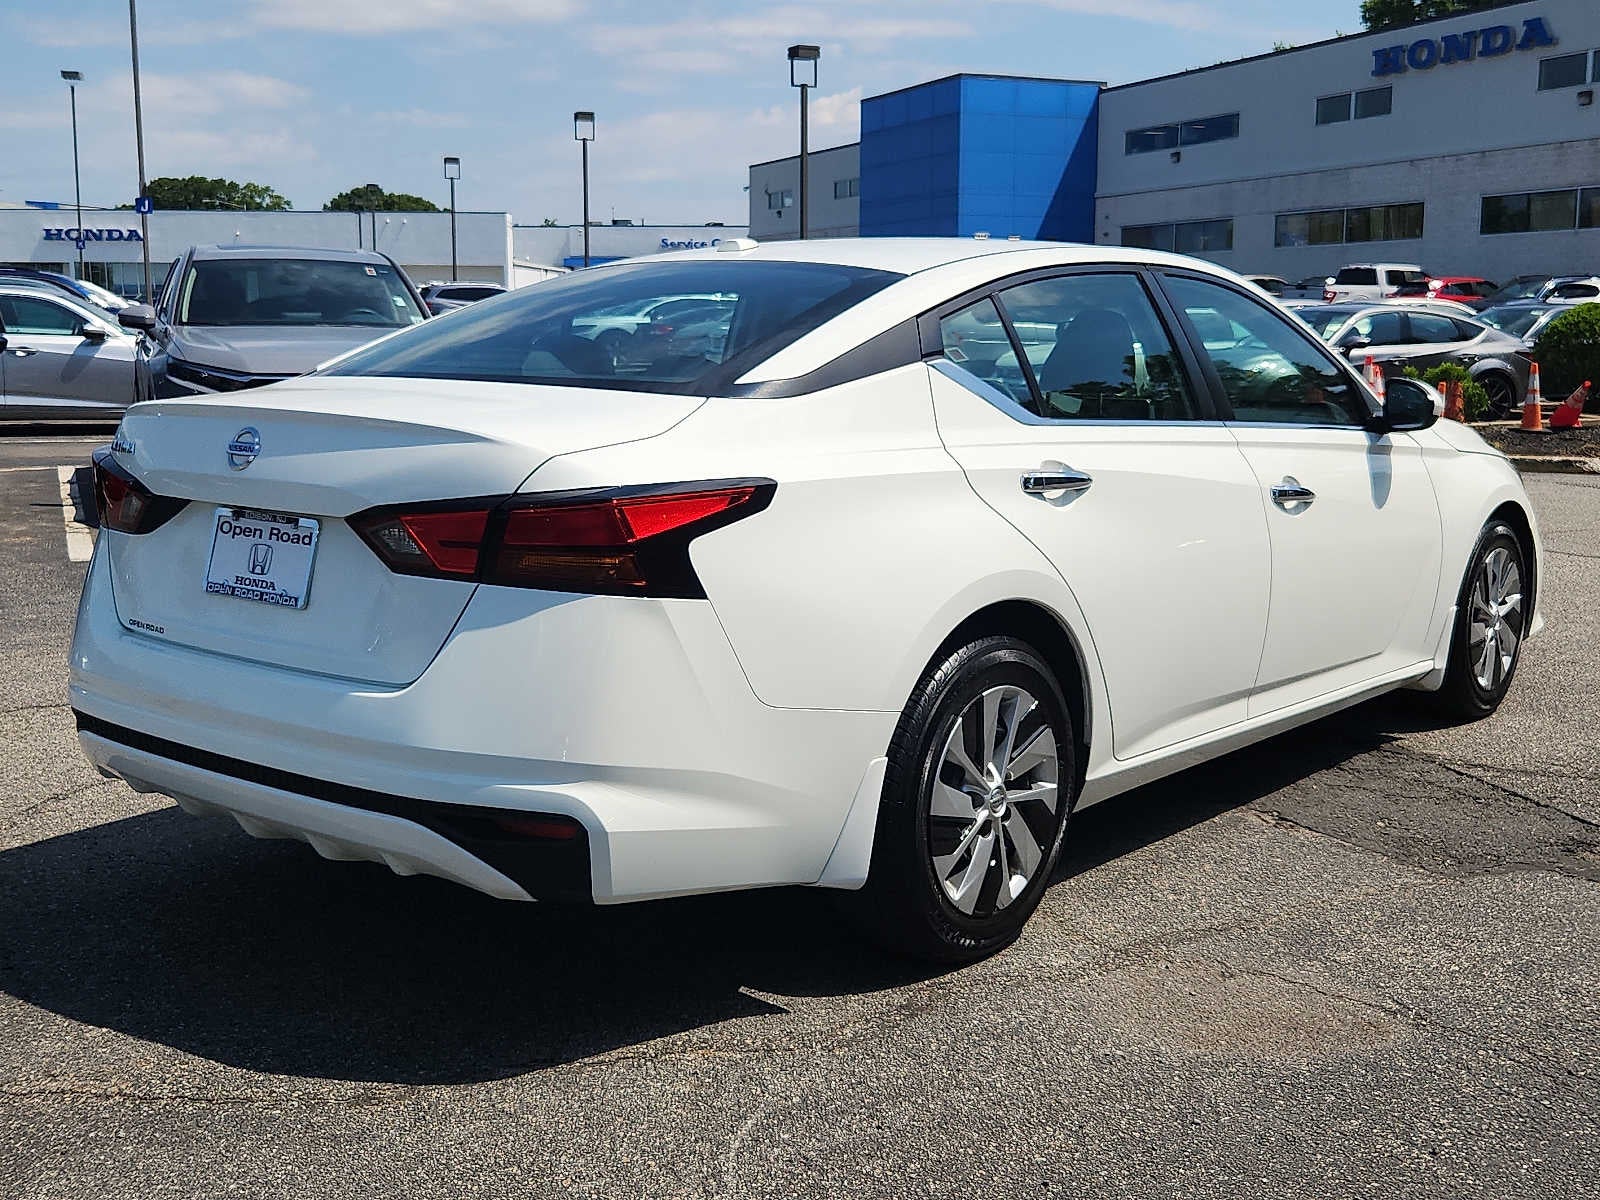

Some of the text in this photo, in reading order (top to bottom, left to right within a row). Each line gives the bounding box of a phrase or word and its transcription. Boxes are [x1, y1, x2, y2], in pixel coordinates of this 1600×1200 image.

[1371, 17, 1557, 76] HONDA
[140, 199, 149, 211] J
[43, 229, 144, 241] HONDA
[661, 238, 708, 250] Service
[220, 520, 313, 546] Open Road
[234, 575, 276, 591] HONDA
[207, 582, 296, 607] OPEN ROAD HONDA
